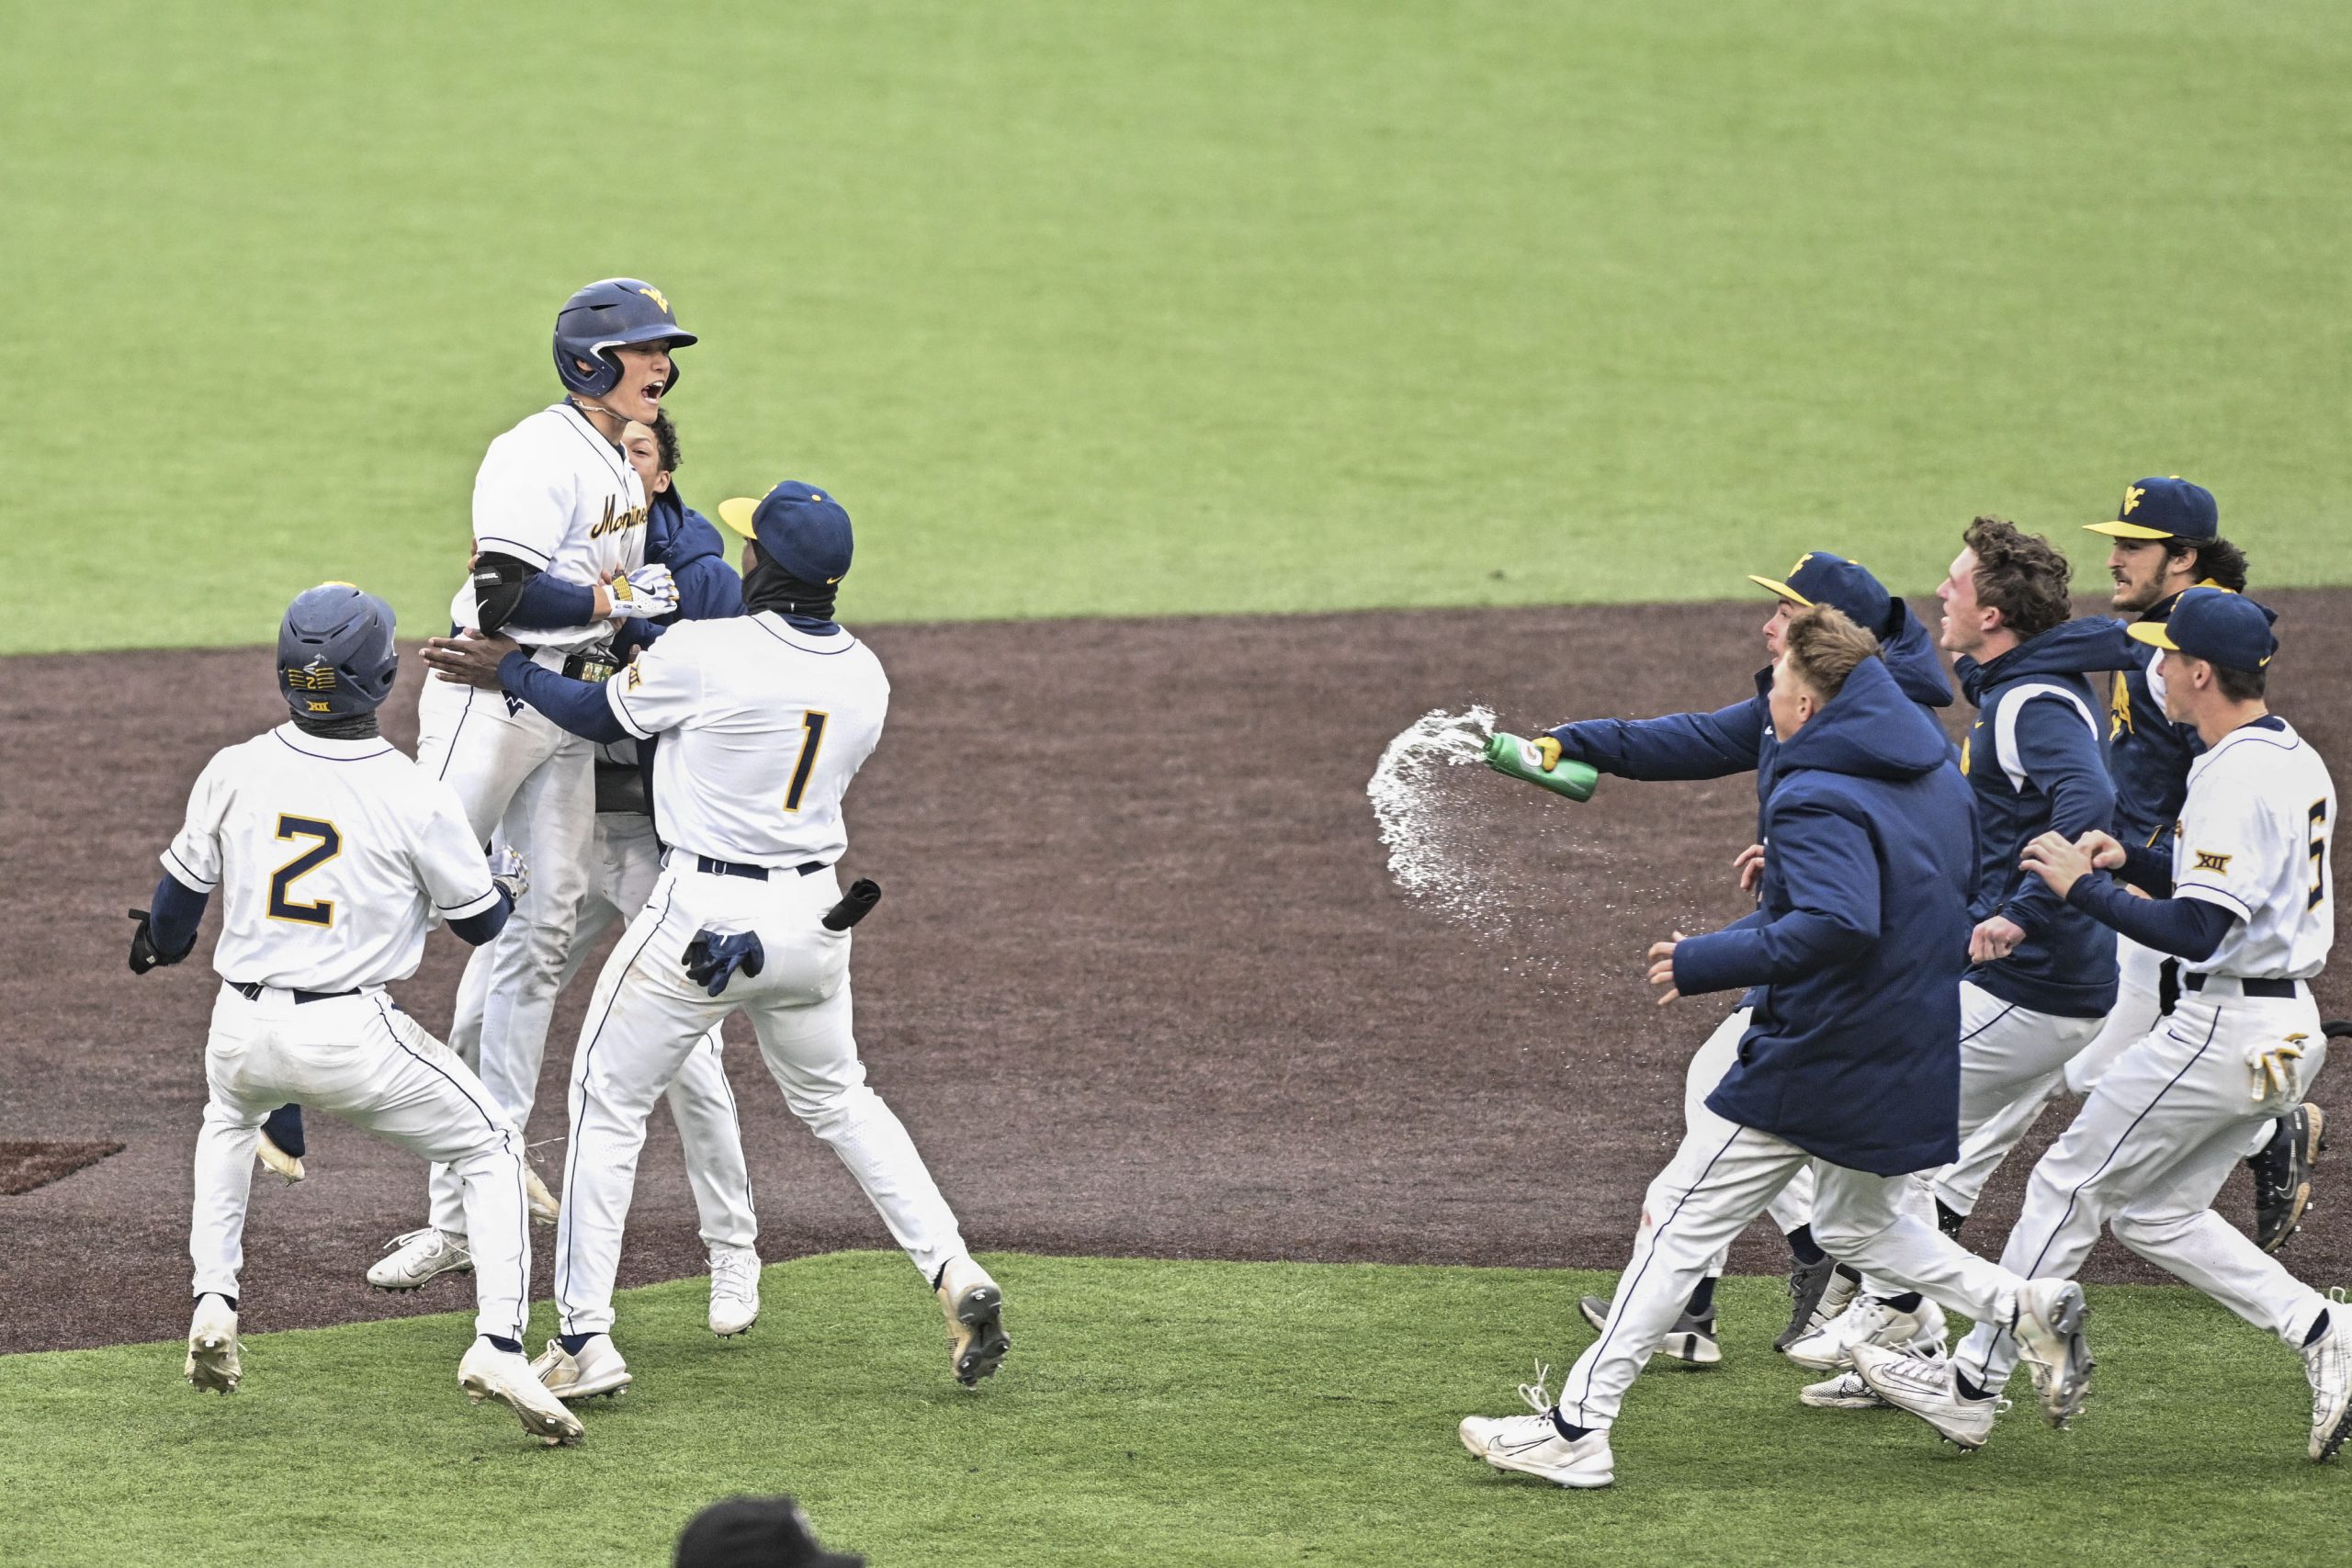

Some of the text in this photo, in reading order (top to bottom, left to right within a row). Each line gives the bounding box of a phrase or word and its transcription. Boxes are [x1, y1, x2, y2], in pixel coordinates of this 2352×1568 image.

[782, 709, 830, 813] 1
[266, 812, 344, 929] 2
[2190, 850, 2233, 877] XII
